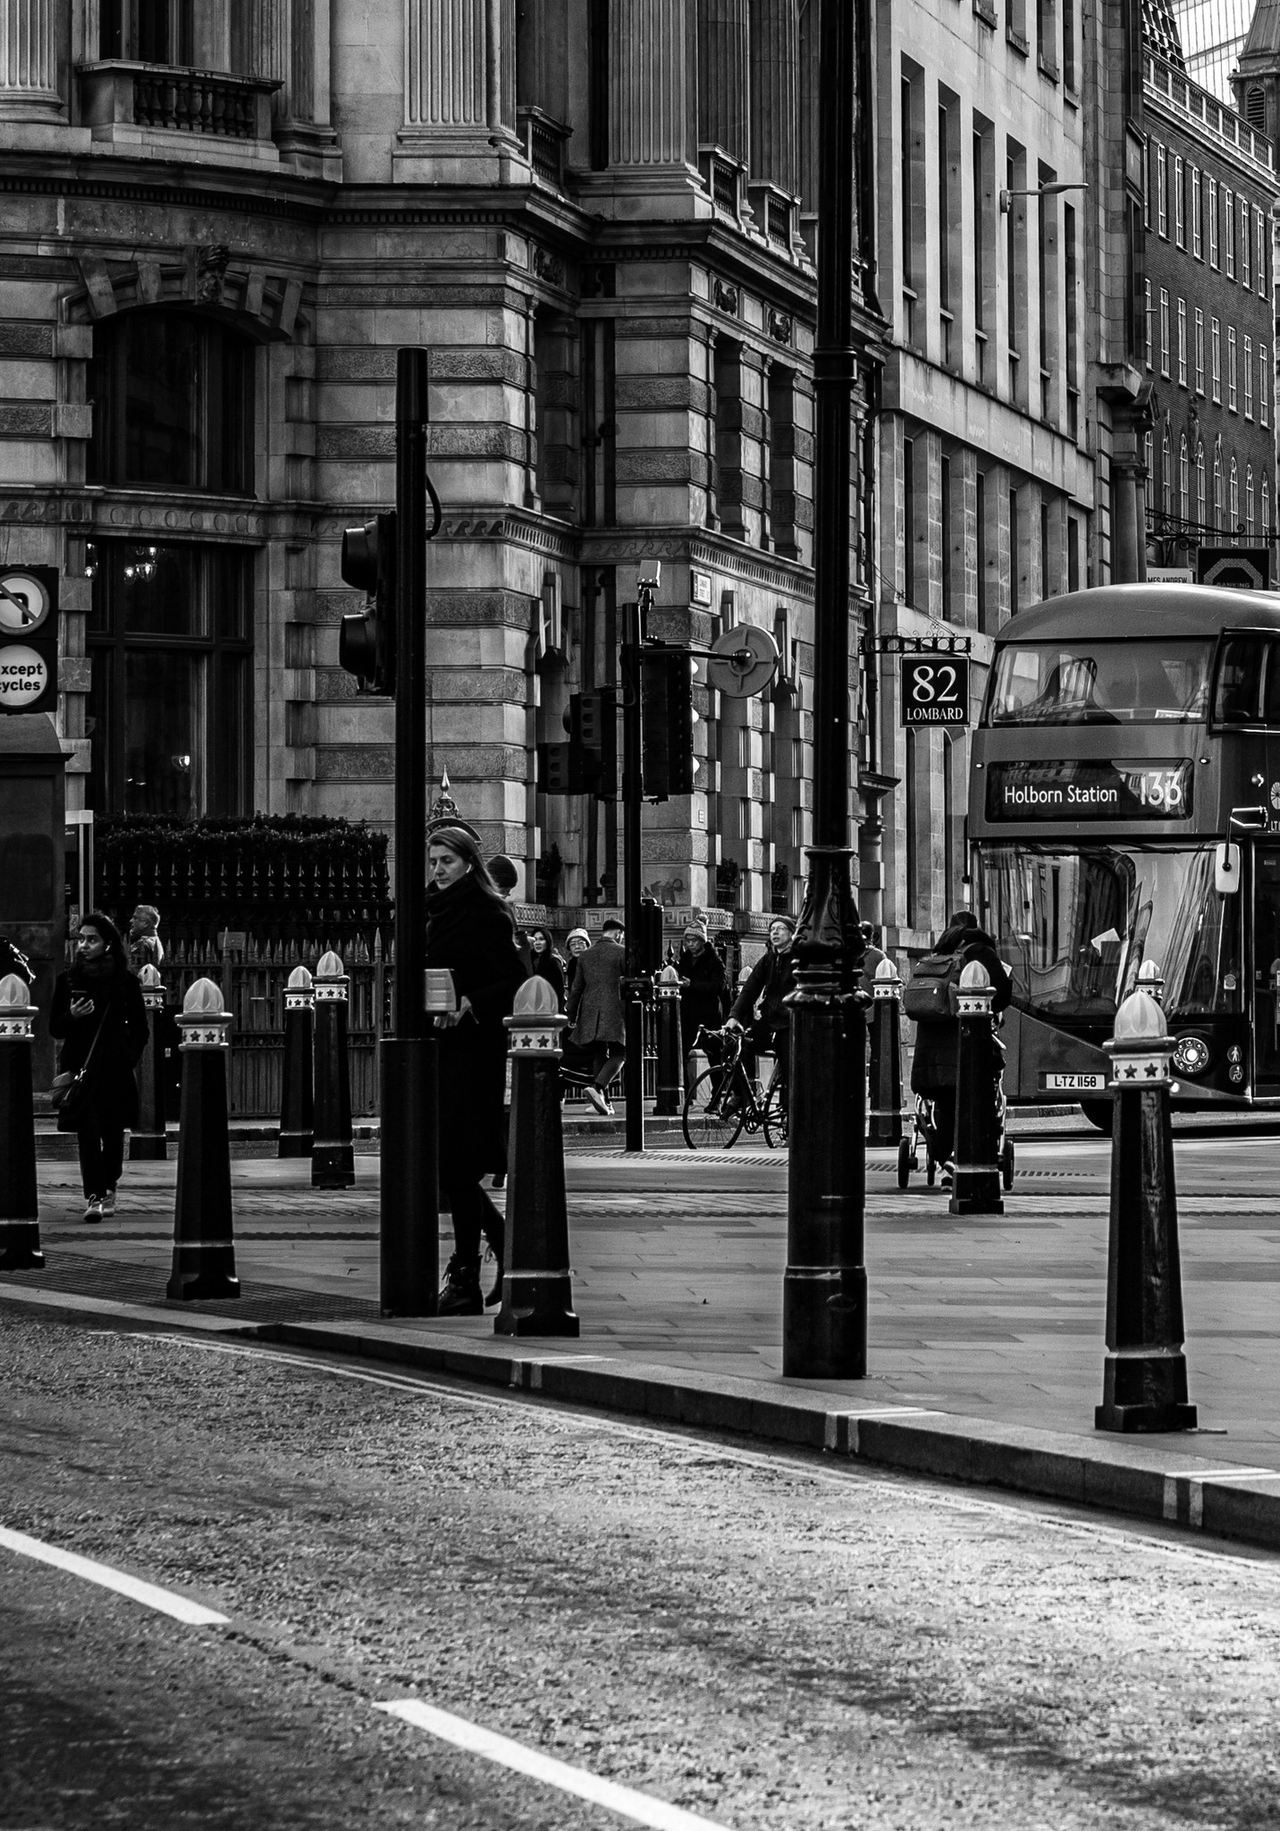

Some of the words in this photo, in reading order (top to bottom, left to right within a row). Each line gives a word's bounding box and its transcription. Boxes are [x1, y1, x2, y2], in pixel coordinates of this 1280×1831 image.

[0, 663, 43, 677] xcept
[912, 665, 959, 702] 82
[907, 707, 964, 721] LOMBARD
[1004, 785, 1063, 804] Holborn
[1067, 784, 1118, 802] Station
[1140, 771, 1183, 806] 133
[1077, 1075, 1097, 1087] 1158
